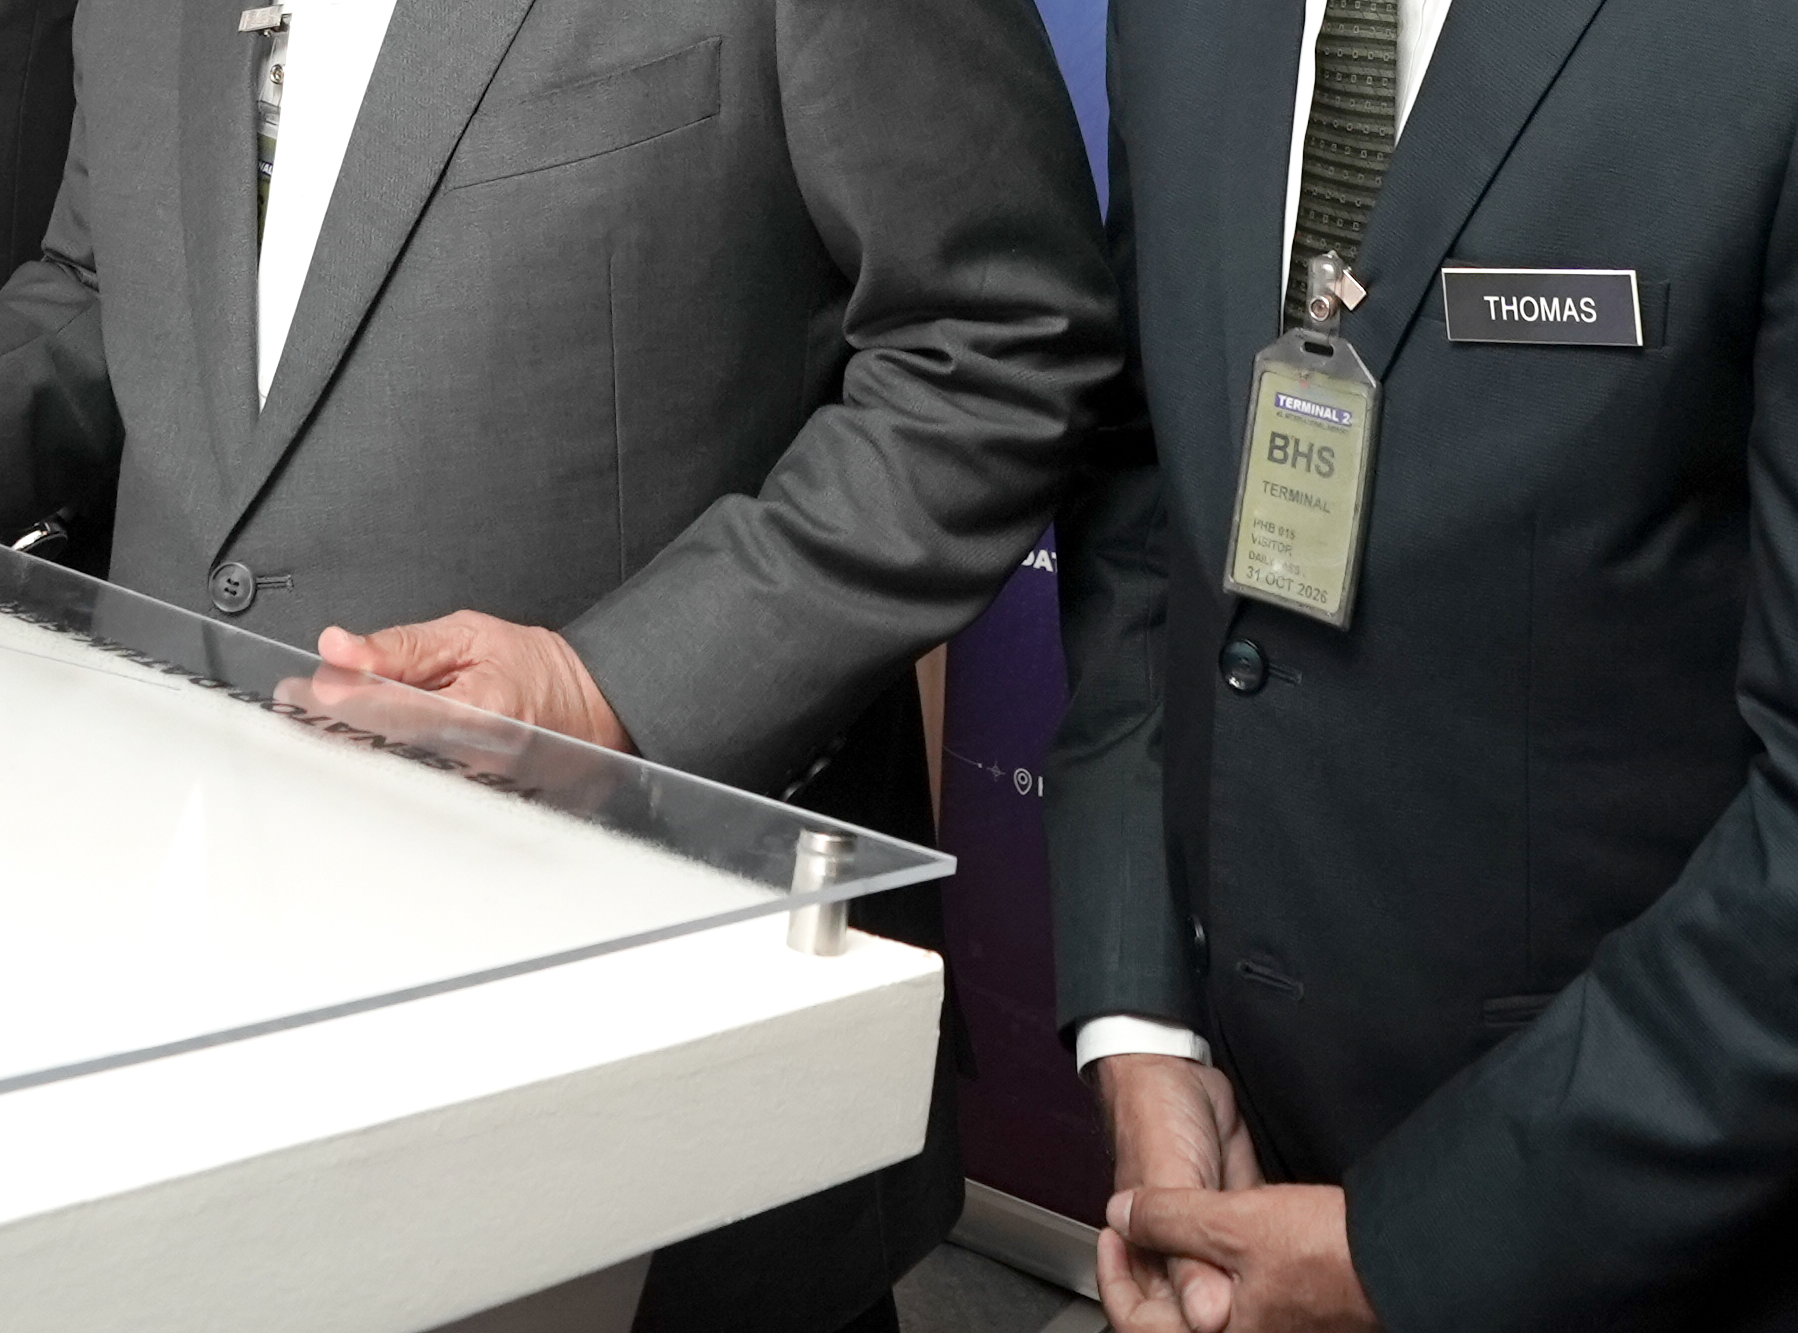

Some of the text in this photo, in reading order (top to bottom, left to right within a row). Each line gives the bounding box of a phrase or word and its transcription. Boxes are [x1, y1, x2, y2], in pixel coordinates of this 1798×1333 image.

[1483, 295, 1598, 324] THOMAS
[1277, 393, 1351, 426] TERMINAL 2
[1267, 430, 1336, 480] BHS
[1262, 480, 1331, 514] TERMINAL
[1253, 517, 1276, 534] PHB
[1251, 534, 1293, 556] VISITOR
[1246, 565, 1329, 606] 31 OCT 2026
